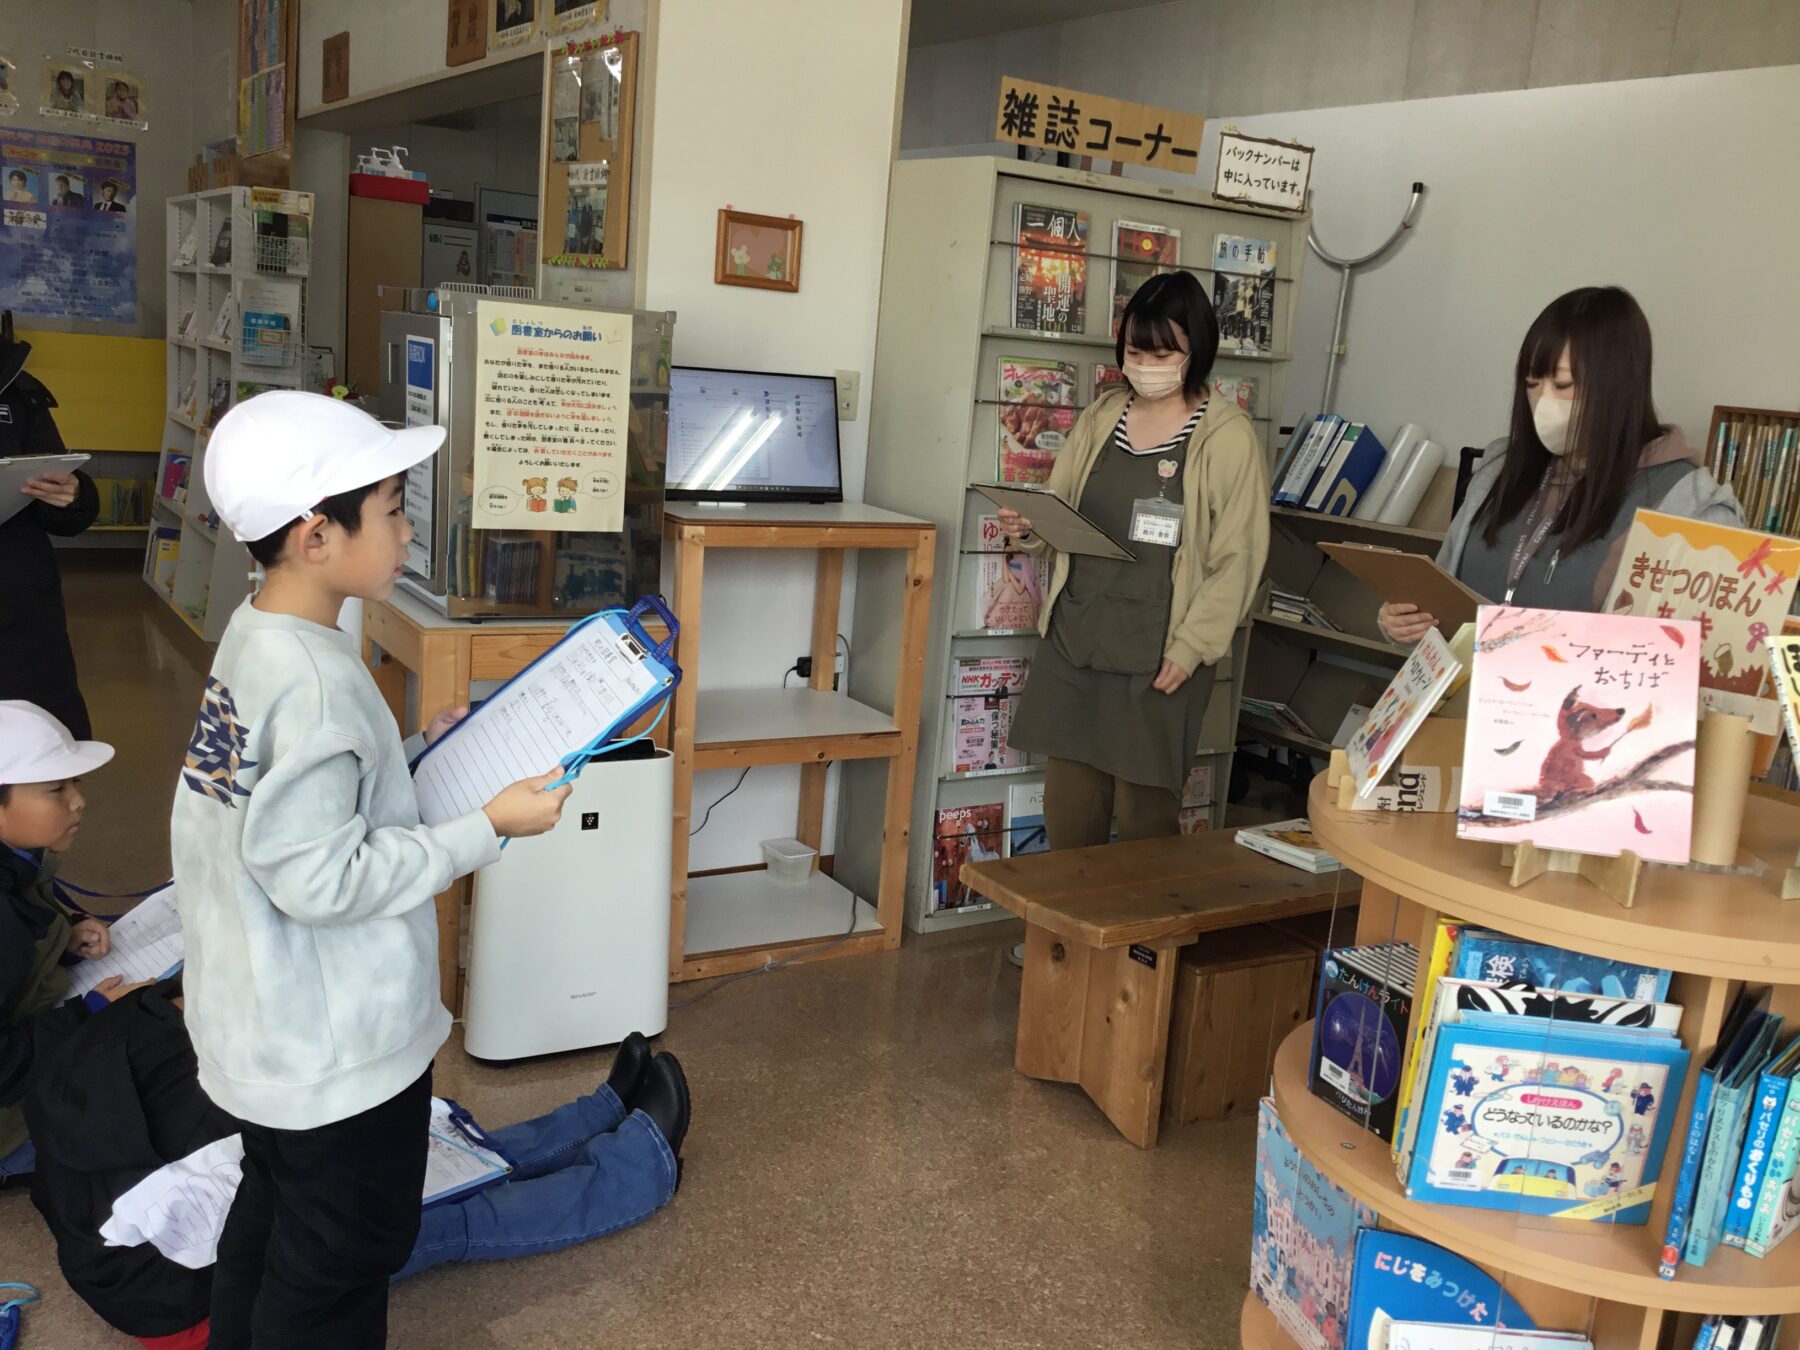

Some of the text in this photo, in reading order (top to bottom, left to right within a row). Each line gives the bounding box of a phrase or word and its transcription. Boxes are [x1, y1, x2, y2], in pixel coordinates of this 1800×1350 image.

[1001, 87, 1198, 162] 雑誌コーナー
[1225, 146, 1301, 172] バックナンバーは
[1224, 170, 1301, 197] 中に入っています。
[1026, 214, 1081, 242] 一個人
[1218, 239, 1265, 264] 旅の手帖
[1042, 285, 1057, 322] 聖地
[1056, 275, 1072, 323] 開運の
[511, 324, 602, 342] 図書室からのお願い
[1629, 552, 1762, 617] きせつのほん
[1568, 642, 1675, 666] ファーディと
[961, 675, 980, 685] NHK
[1411, 654, 1433, 690] ハロウィーン
[1594, 667, 1670, 690] おちば
[1416, 774, 1428, 810] レジェンド
[939, 808, 972, 824] peeps
[1338, 967, 1409, 1014] たんけんライト
[1526, 1094, 1578, 1109] しかけえほん
[1482, 1107, 1613, 1134] どうなっているのかな?
[1736, 1111, 1773, 1210] パセリのおくりもの
[1374, 1251, 1507, 1329] にじをみつけた
